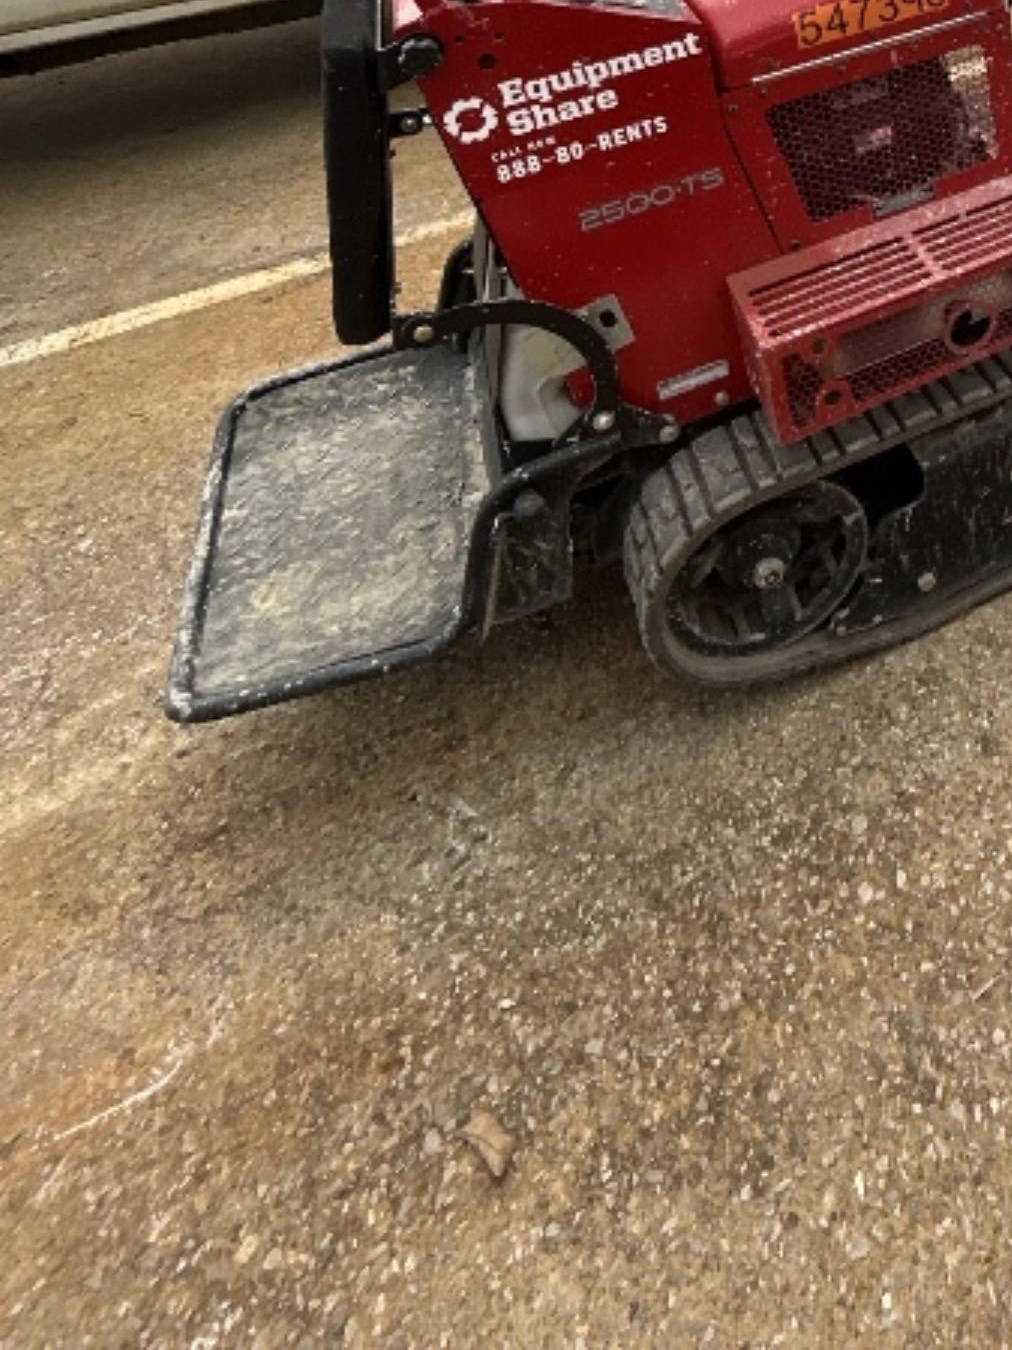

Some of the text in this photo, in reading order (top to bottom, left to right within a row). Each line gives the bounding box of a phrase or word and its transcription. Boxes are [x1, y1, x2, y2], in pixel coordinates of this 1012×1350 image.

[497, 31, 703, 108] Equipment
[506, 88, 619, 135] Share
[496, 115, 668, 183] 888-80-RENTS
